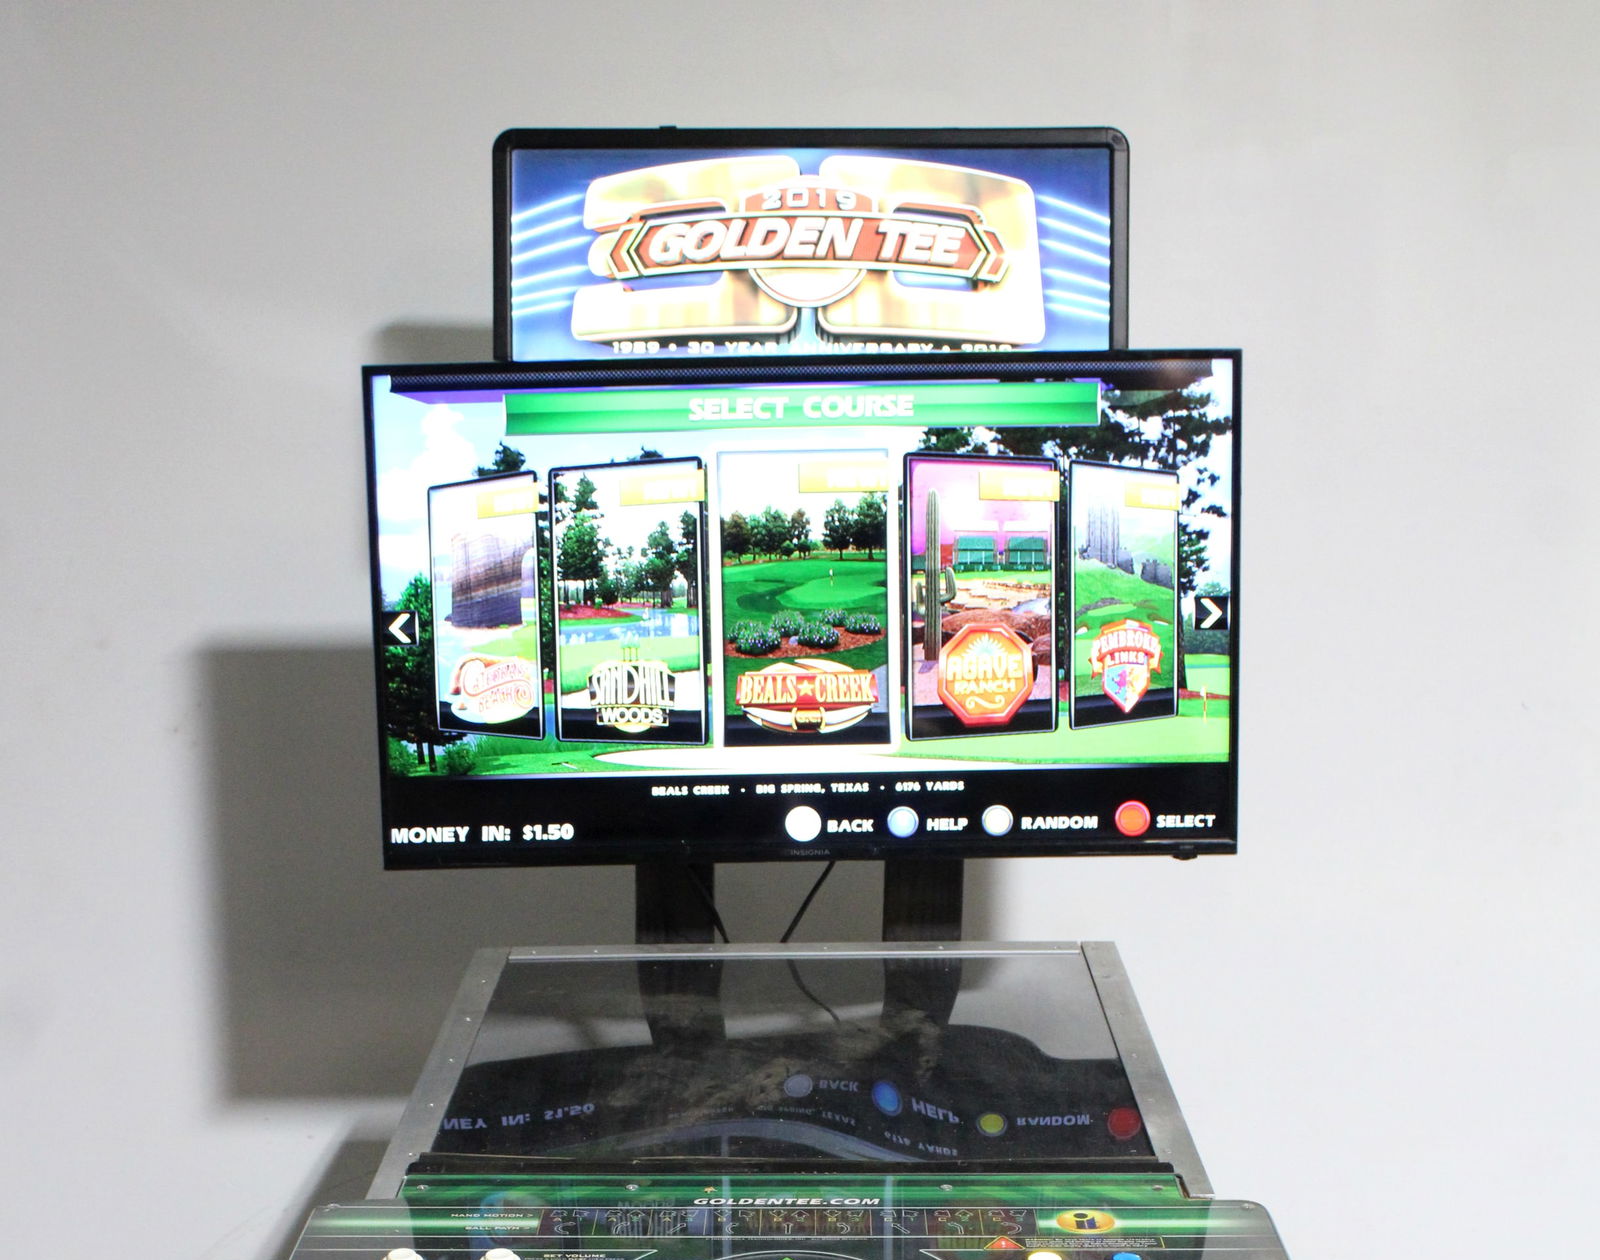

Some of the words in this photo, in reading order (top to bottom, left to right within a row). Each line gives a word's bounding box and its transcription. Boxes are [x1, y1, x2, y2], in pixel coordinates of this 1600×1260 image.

[761, 187, 857, 210] 2019
[648, 216, 864, 264] GOLDEN
[877, 218, 965, 265] TEE
[725, 341, 777, 354] YEAR
[688, 397, 789, 421] SELECT
[803, 394, 914, 418] COURSE
[947, 654, 1023, 680] AGAVE
[589, 661, 675, 706] SANDHILL
[739, 673, 798, 704] BEALS
[814, 672, 876, 703] CREEK
[953, 680, 1017, 694] RANCH
[601, 707, 665, 724] WOODS
[651, 785, 689, 797] BEALS
[692, 785, 730, 796] CREEK
[755, 784, 776, 795] BIG
[831, 782, 869, 793] TEXAS
[925, 781, 965, 792] YARDS
[827, 819, 874, 833] BACK
[926, 817, 969, 832] HELP
[1021, 815, 1099, 830] RANDOM
[1156, 814, 1216, 828] SELECT
[390, 826, 470, 844] MONEY
[481, 825, 511, 842] IN:
[522, 823, 575, 841] $1.50
[693, 1198, 880, 1206] GOLDENTEE.COM
